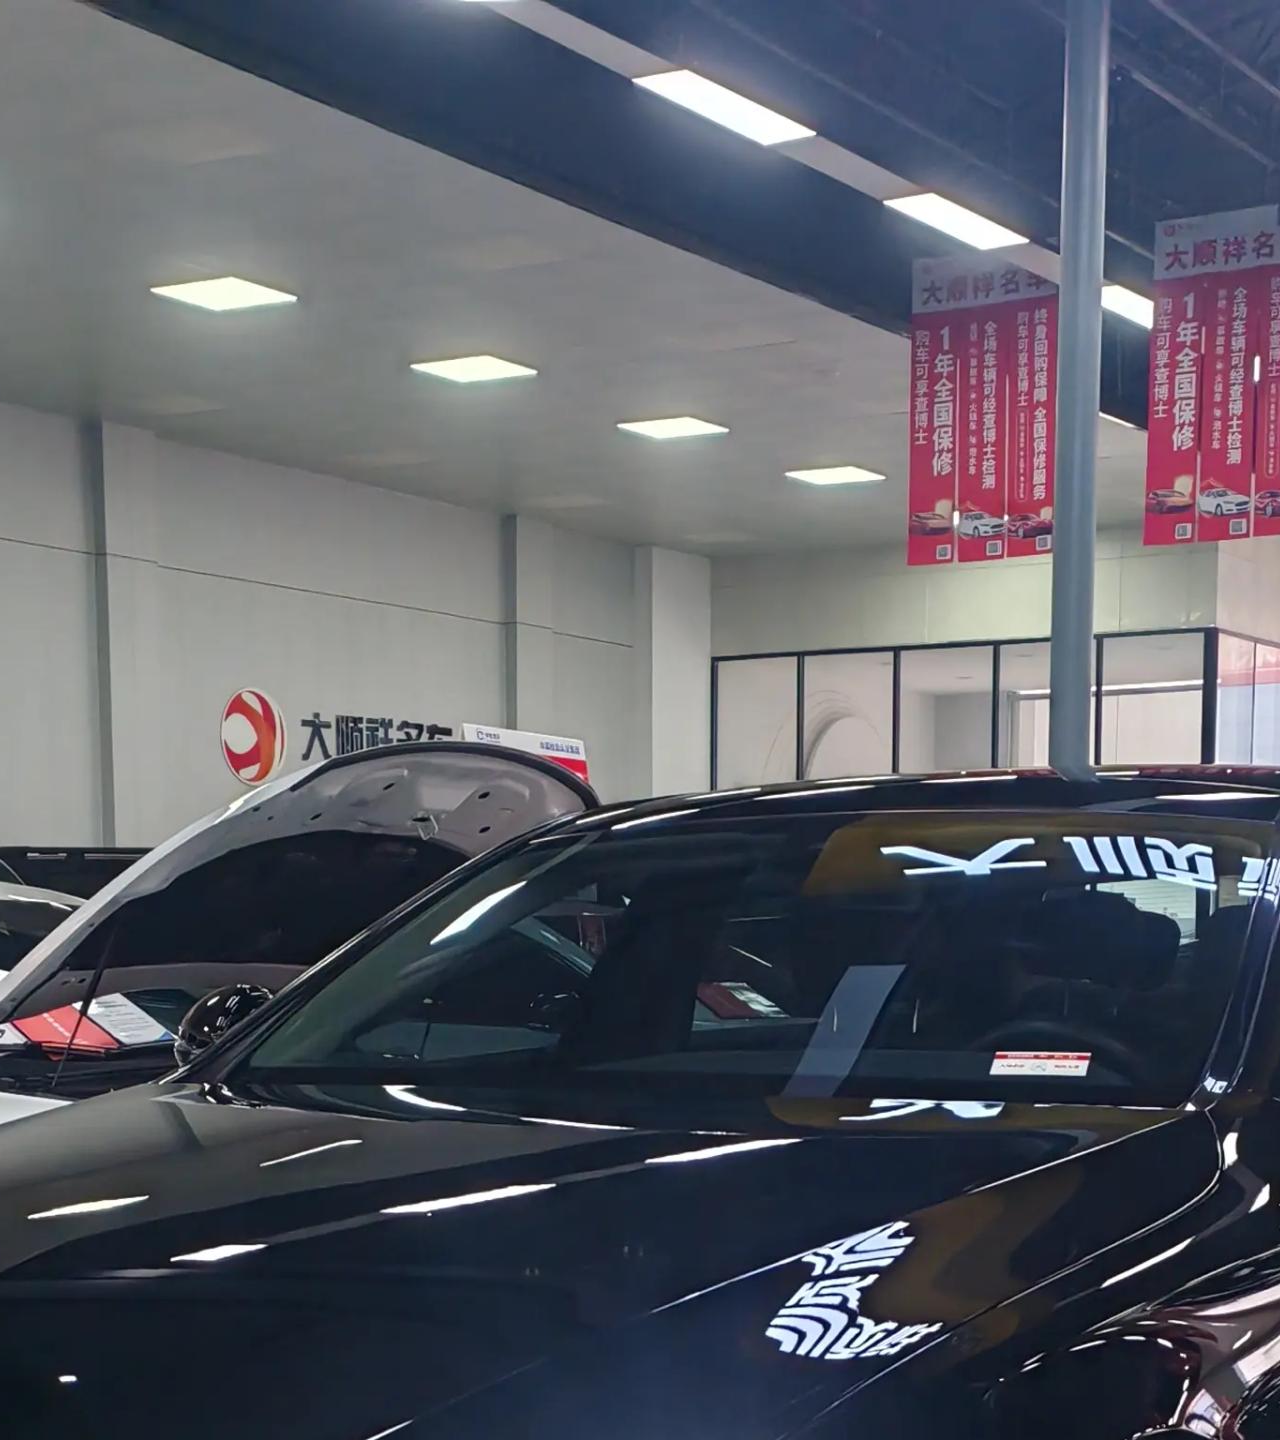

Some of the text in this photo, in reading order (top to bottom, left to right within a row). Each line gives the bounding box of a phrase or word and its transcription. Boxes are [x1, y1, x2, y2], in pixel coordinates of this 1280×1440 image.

[932, 326, 954, 477] 1年全国保修
[1172, 292, 1199, 452] 1年全国保修
